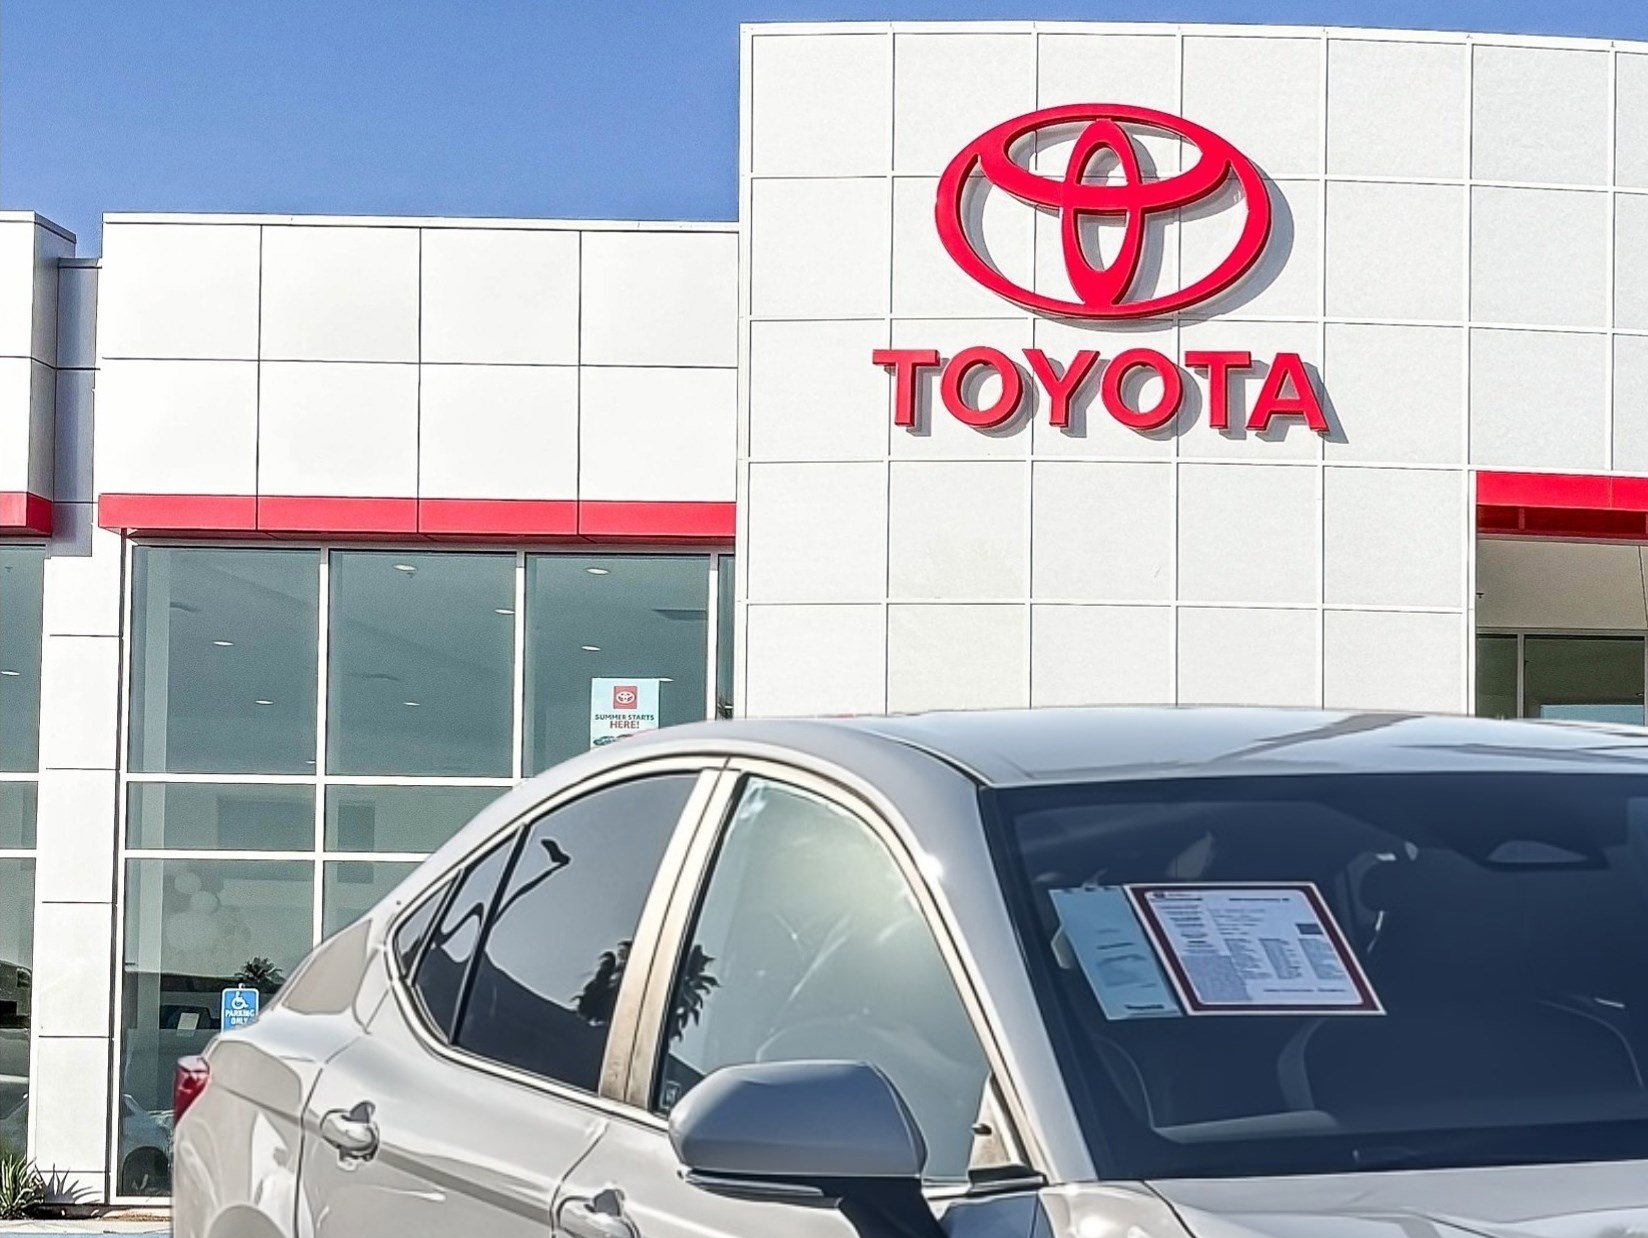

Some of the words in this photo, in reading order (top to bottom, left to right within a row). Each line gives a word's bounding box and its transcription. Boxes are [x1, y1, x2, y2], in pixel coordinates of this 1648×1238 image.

[872, 345, 1330, 435] TOYOTA
[594, 713, 627, 721] SUMMER
[609, 720, 640, 729] HERE!
